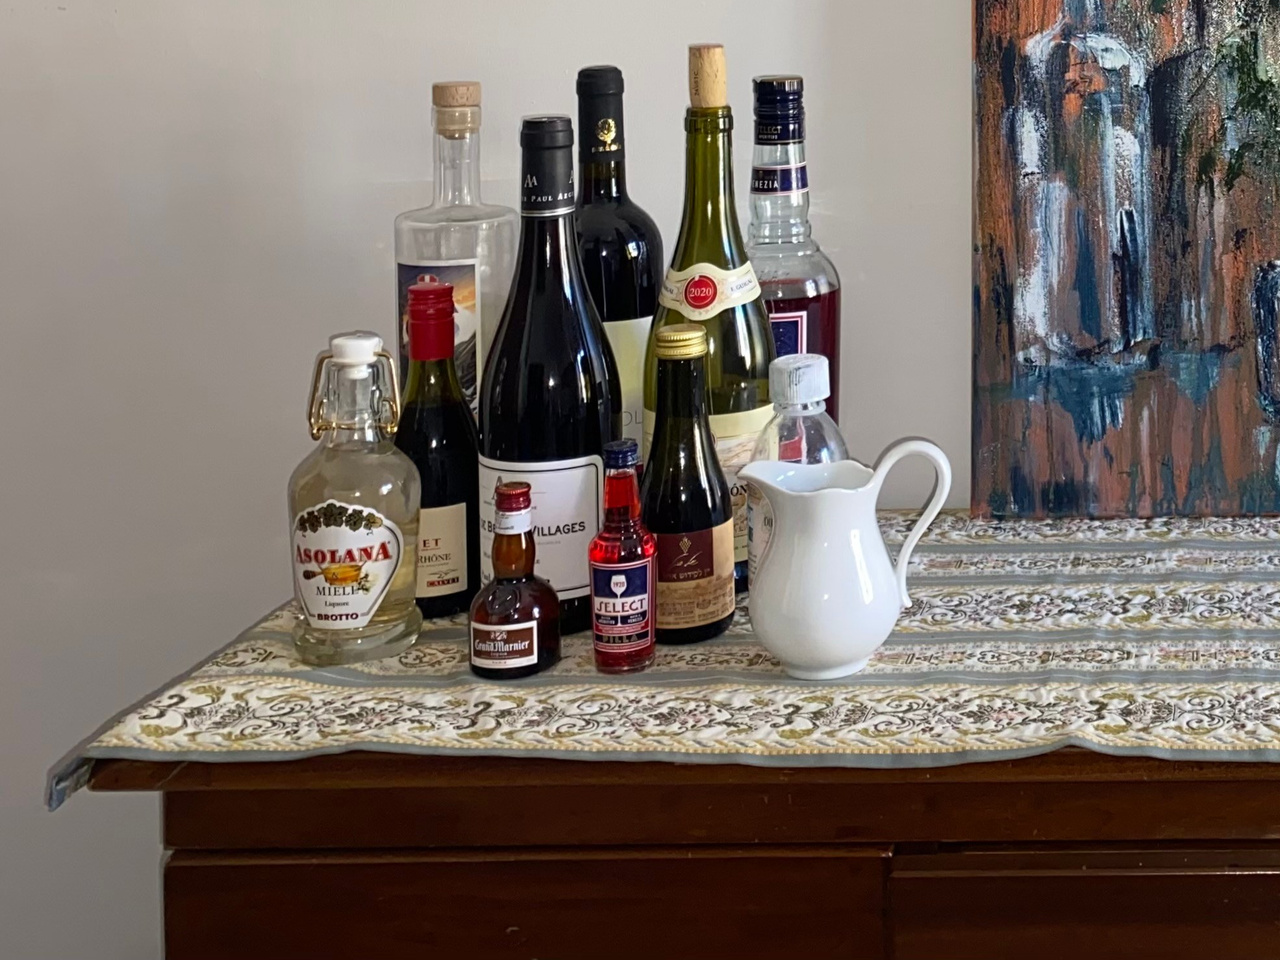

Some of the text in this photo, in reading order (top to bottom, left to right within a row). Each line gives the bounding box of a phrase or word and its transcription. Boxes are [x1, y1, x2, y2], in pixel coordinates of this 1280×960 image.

[752, 180, 779, 190] ENEZIA
[690, 288, 712, 297] 2020
[296, 541, 392, 564] ASOLANA
[418, 553, 452, 565] RHÔNE
[597, 598, 646, 613] SELECT
[317, 613, 359, 621] BROTTO
[603, 634, 639, 644] PILLA
[494, 640, 530, 652] Marnier
